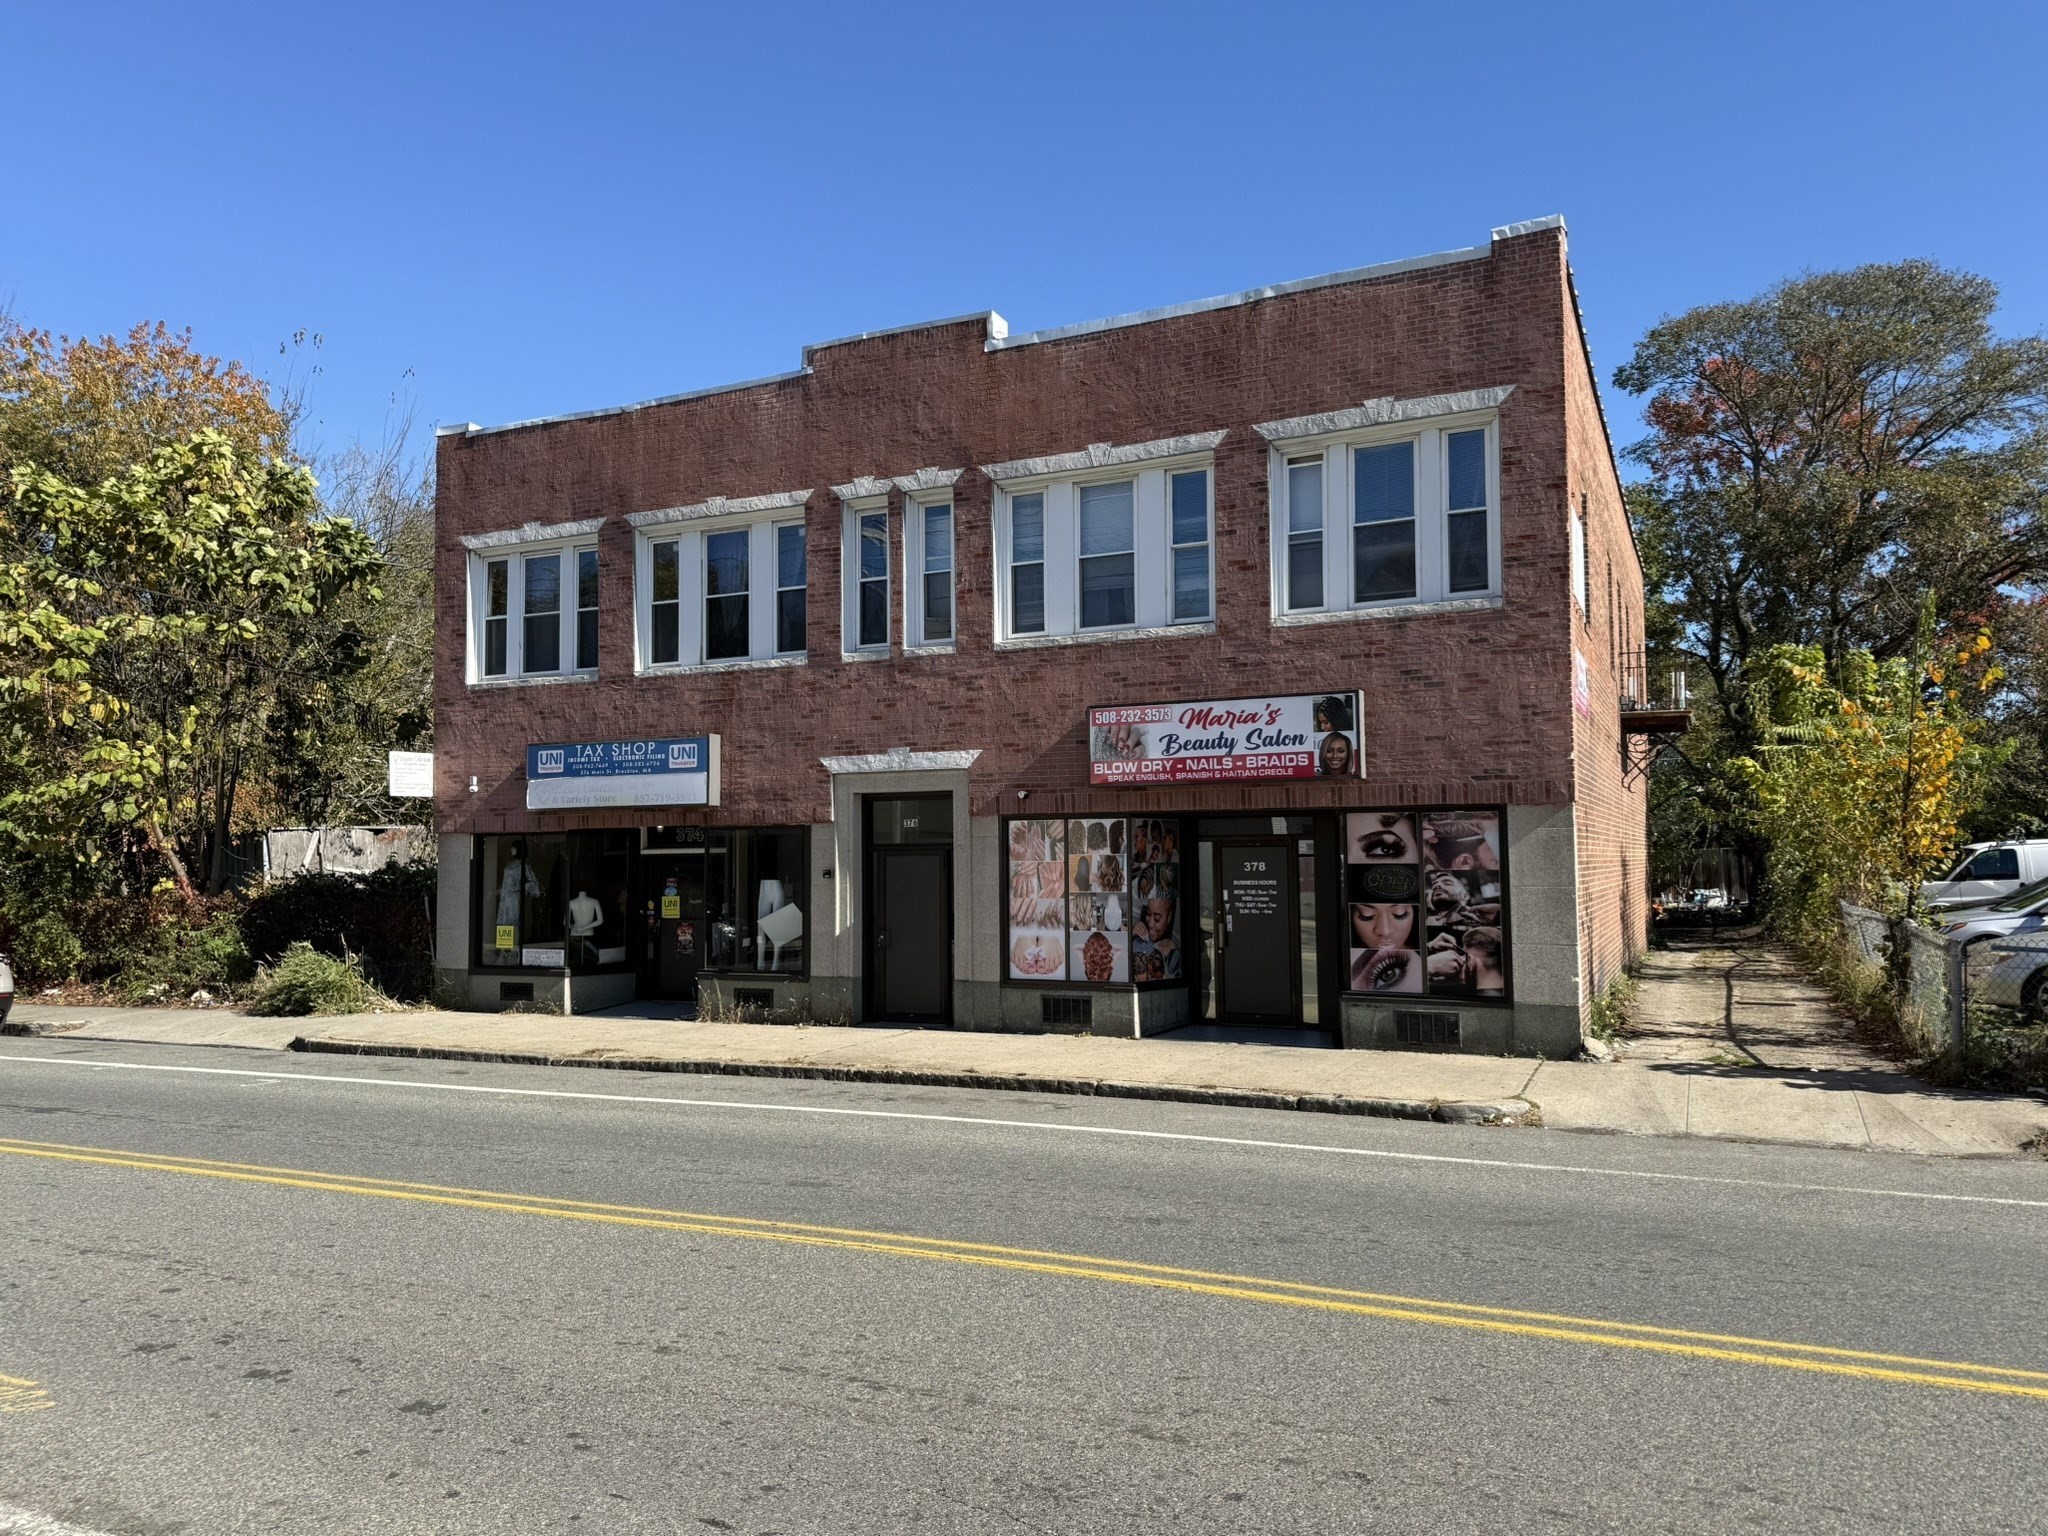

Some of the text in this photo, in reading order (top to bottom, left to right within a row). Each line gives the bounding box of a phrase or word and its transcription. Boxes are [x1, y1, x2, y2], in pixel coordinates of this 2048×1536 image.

[1095, 708, 1172, 724] 508-232-3573
[1178, 703, 1283, 731] Maria's
[1159, 731, 1238, 756] Beauty
[1244, 728, 1308, 751] Salon
[575, 742, 656, 757] TAX SHOP
[670, 746, 696, 760] UNI
[539, 752, 562, 766] UNI
[1094, 762, 1138, 775] BLOW
[1141, 760, 1173, 772] DRY
[1186, 757, 1233, 771] NAILS
[1246, 754, 1309, 768] BRAIDS
[1107, 774, 1135, 782] SPEAK
[1137, 773, 1173, 781] ENGLISH,
[1176, 771, 1213, 780] SPANISH
[1222, 769, 1258, 778] HAITIAN
[1258, 768, 1294, 776] CREOLE
[560, 795, 591, 805] Variety
[593, 794, 617, 803] Store
[676, 827, 705, 841] 374
[1243, 862, 1266, 872] 378
[663, 900, 677, 908] UNI
[498, 929, 512, 938] UNI
